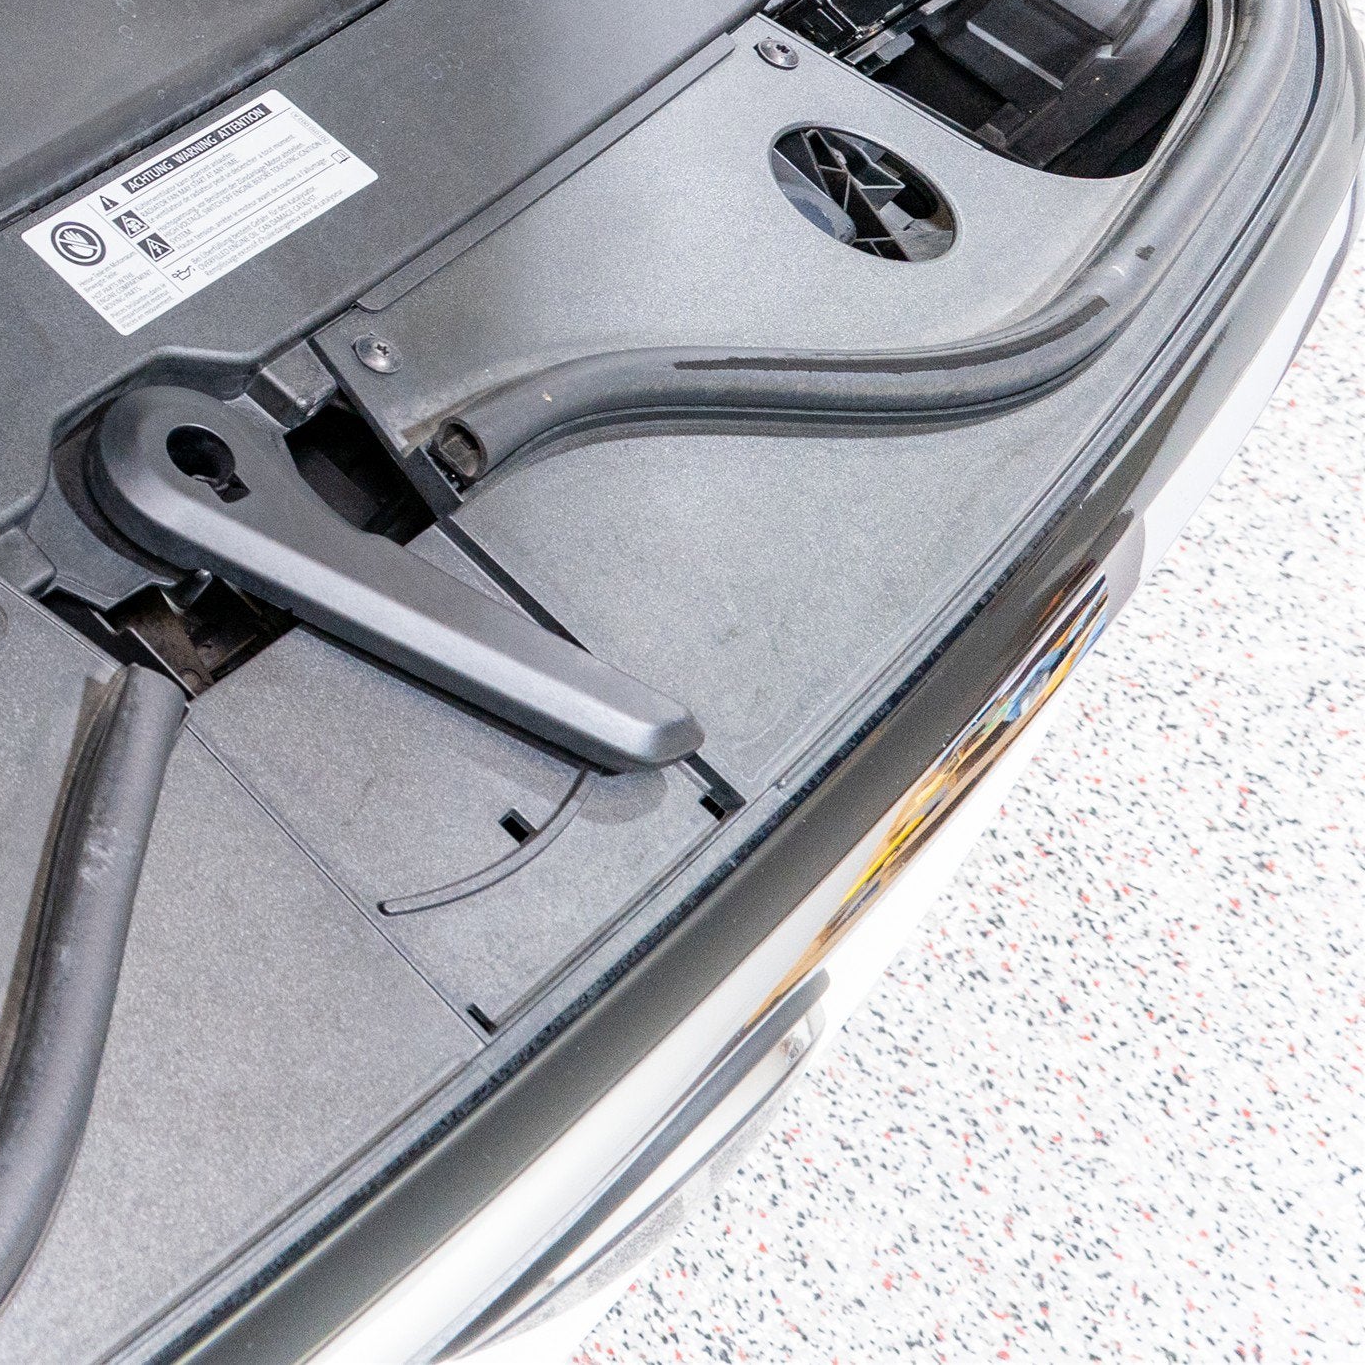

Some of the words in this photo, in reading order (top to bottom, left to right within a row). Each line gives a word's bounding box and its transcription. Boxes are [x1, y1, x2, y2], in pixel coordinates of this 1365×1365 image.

[127, 160, 173, 190] ACHTUNG
[172, 135, 217, 163] WARNING
[217, 107, 264, 138] ATTENTION
